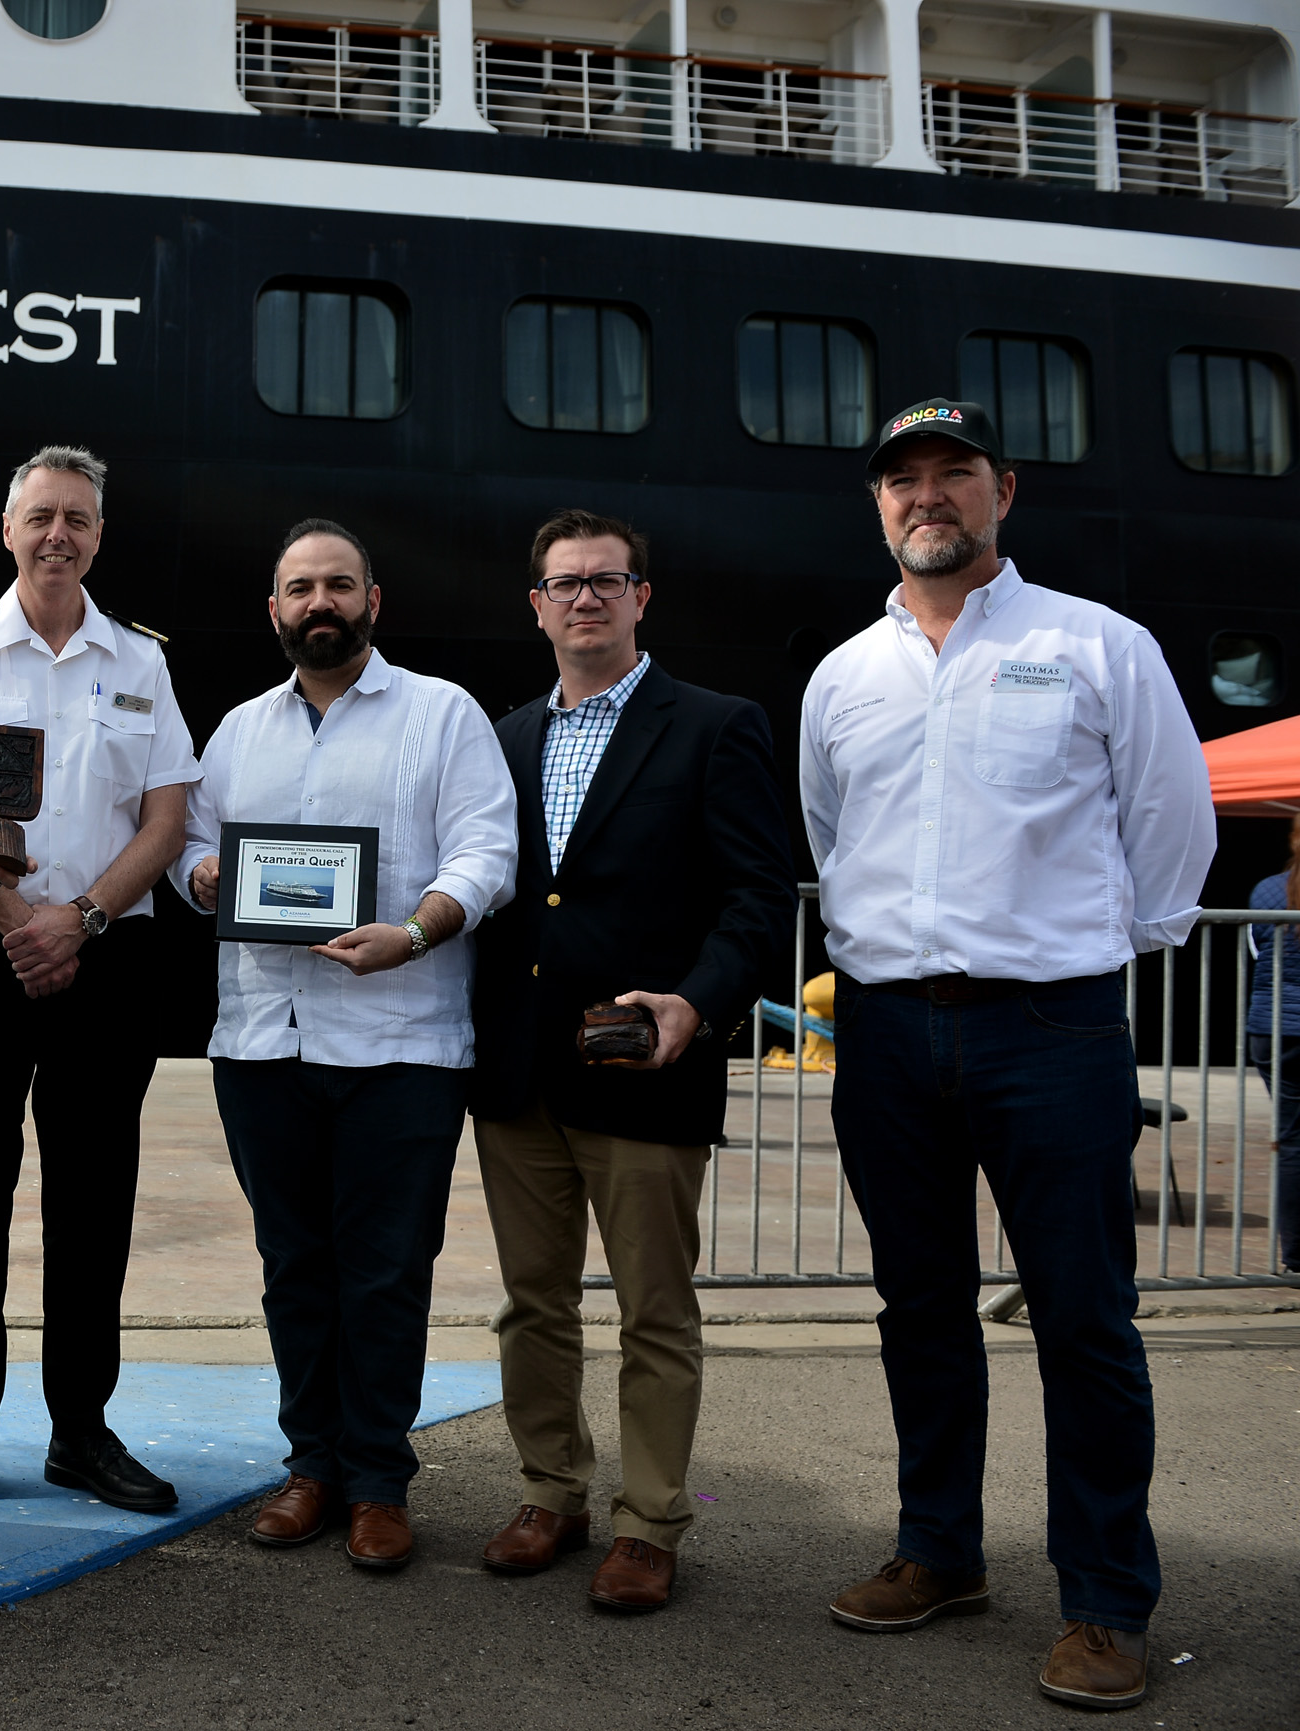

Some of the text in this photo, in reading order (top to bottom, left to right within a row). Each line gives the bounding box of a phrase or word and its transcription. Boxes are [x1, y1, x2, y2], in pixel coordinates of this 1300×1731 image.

[891, 407, 963, 432] SONORA
[1010, 664, 1060, 675] GUAYMAS
[1022, 679, 1050, 687] CRUCEROS
[1023, 675, 1066, 684] INTERNACIONAL
[841, 705, 860, 715] Alberto
[253, 853, 305, 866] Azamara
